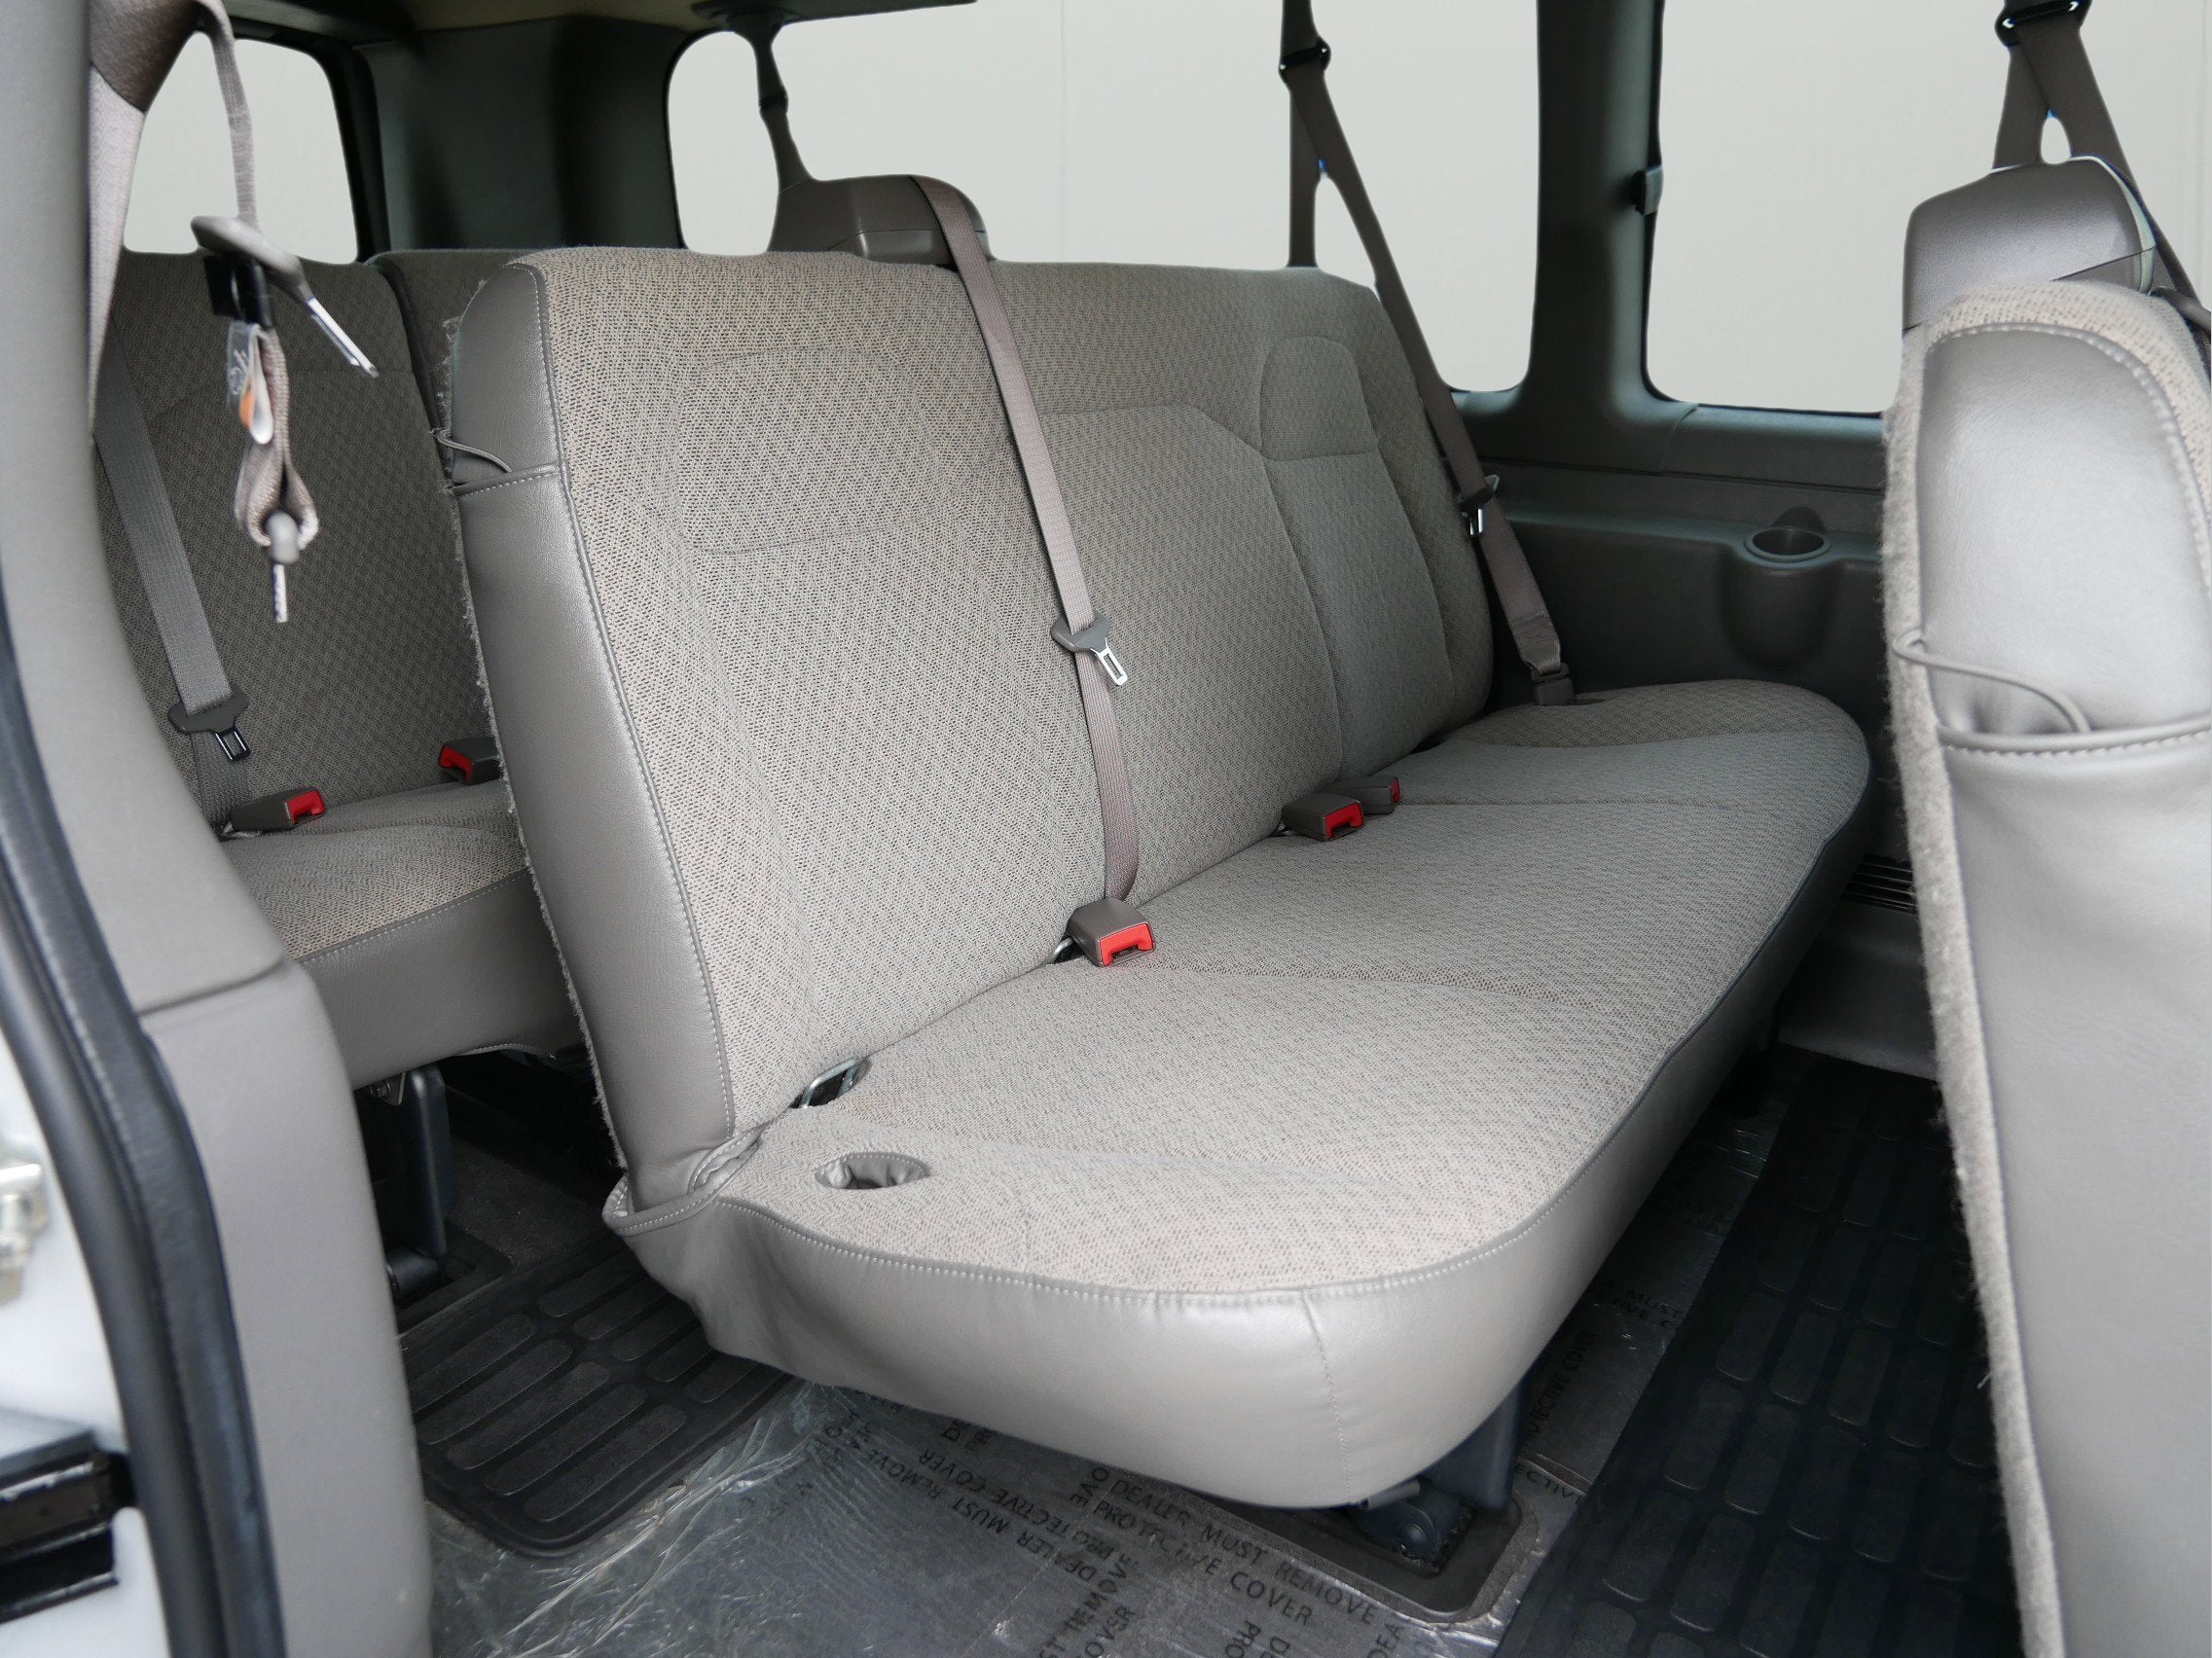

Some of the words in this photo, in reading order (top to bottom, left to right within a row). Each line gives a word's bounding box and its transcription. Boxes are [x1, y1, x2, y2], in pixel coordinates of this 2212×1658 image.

[1523, 1370, 1573, 1444] OTECTIVE
[867, 1450, 944, 1499] REMOVE
[918, 1448, 988, 1494] COVER
[950, 1496, 1011, 1535] MUST
[990, 1487, 1115, 1560] PROTECTIVE
[1015, 1531, 1097, 1582] DEALER
[1109, 1478, 1190, 1529] DEALER
[1201, 1522, 1268, 1566] MUST
[1274, 1560, 1378, 1626] REMOVE
[1064, 1552, 1139, 1633] REMOVE
[1229, 1570, 1313, 1627] COVER
[1080, 1605, 1136, 1658] OVER
